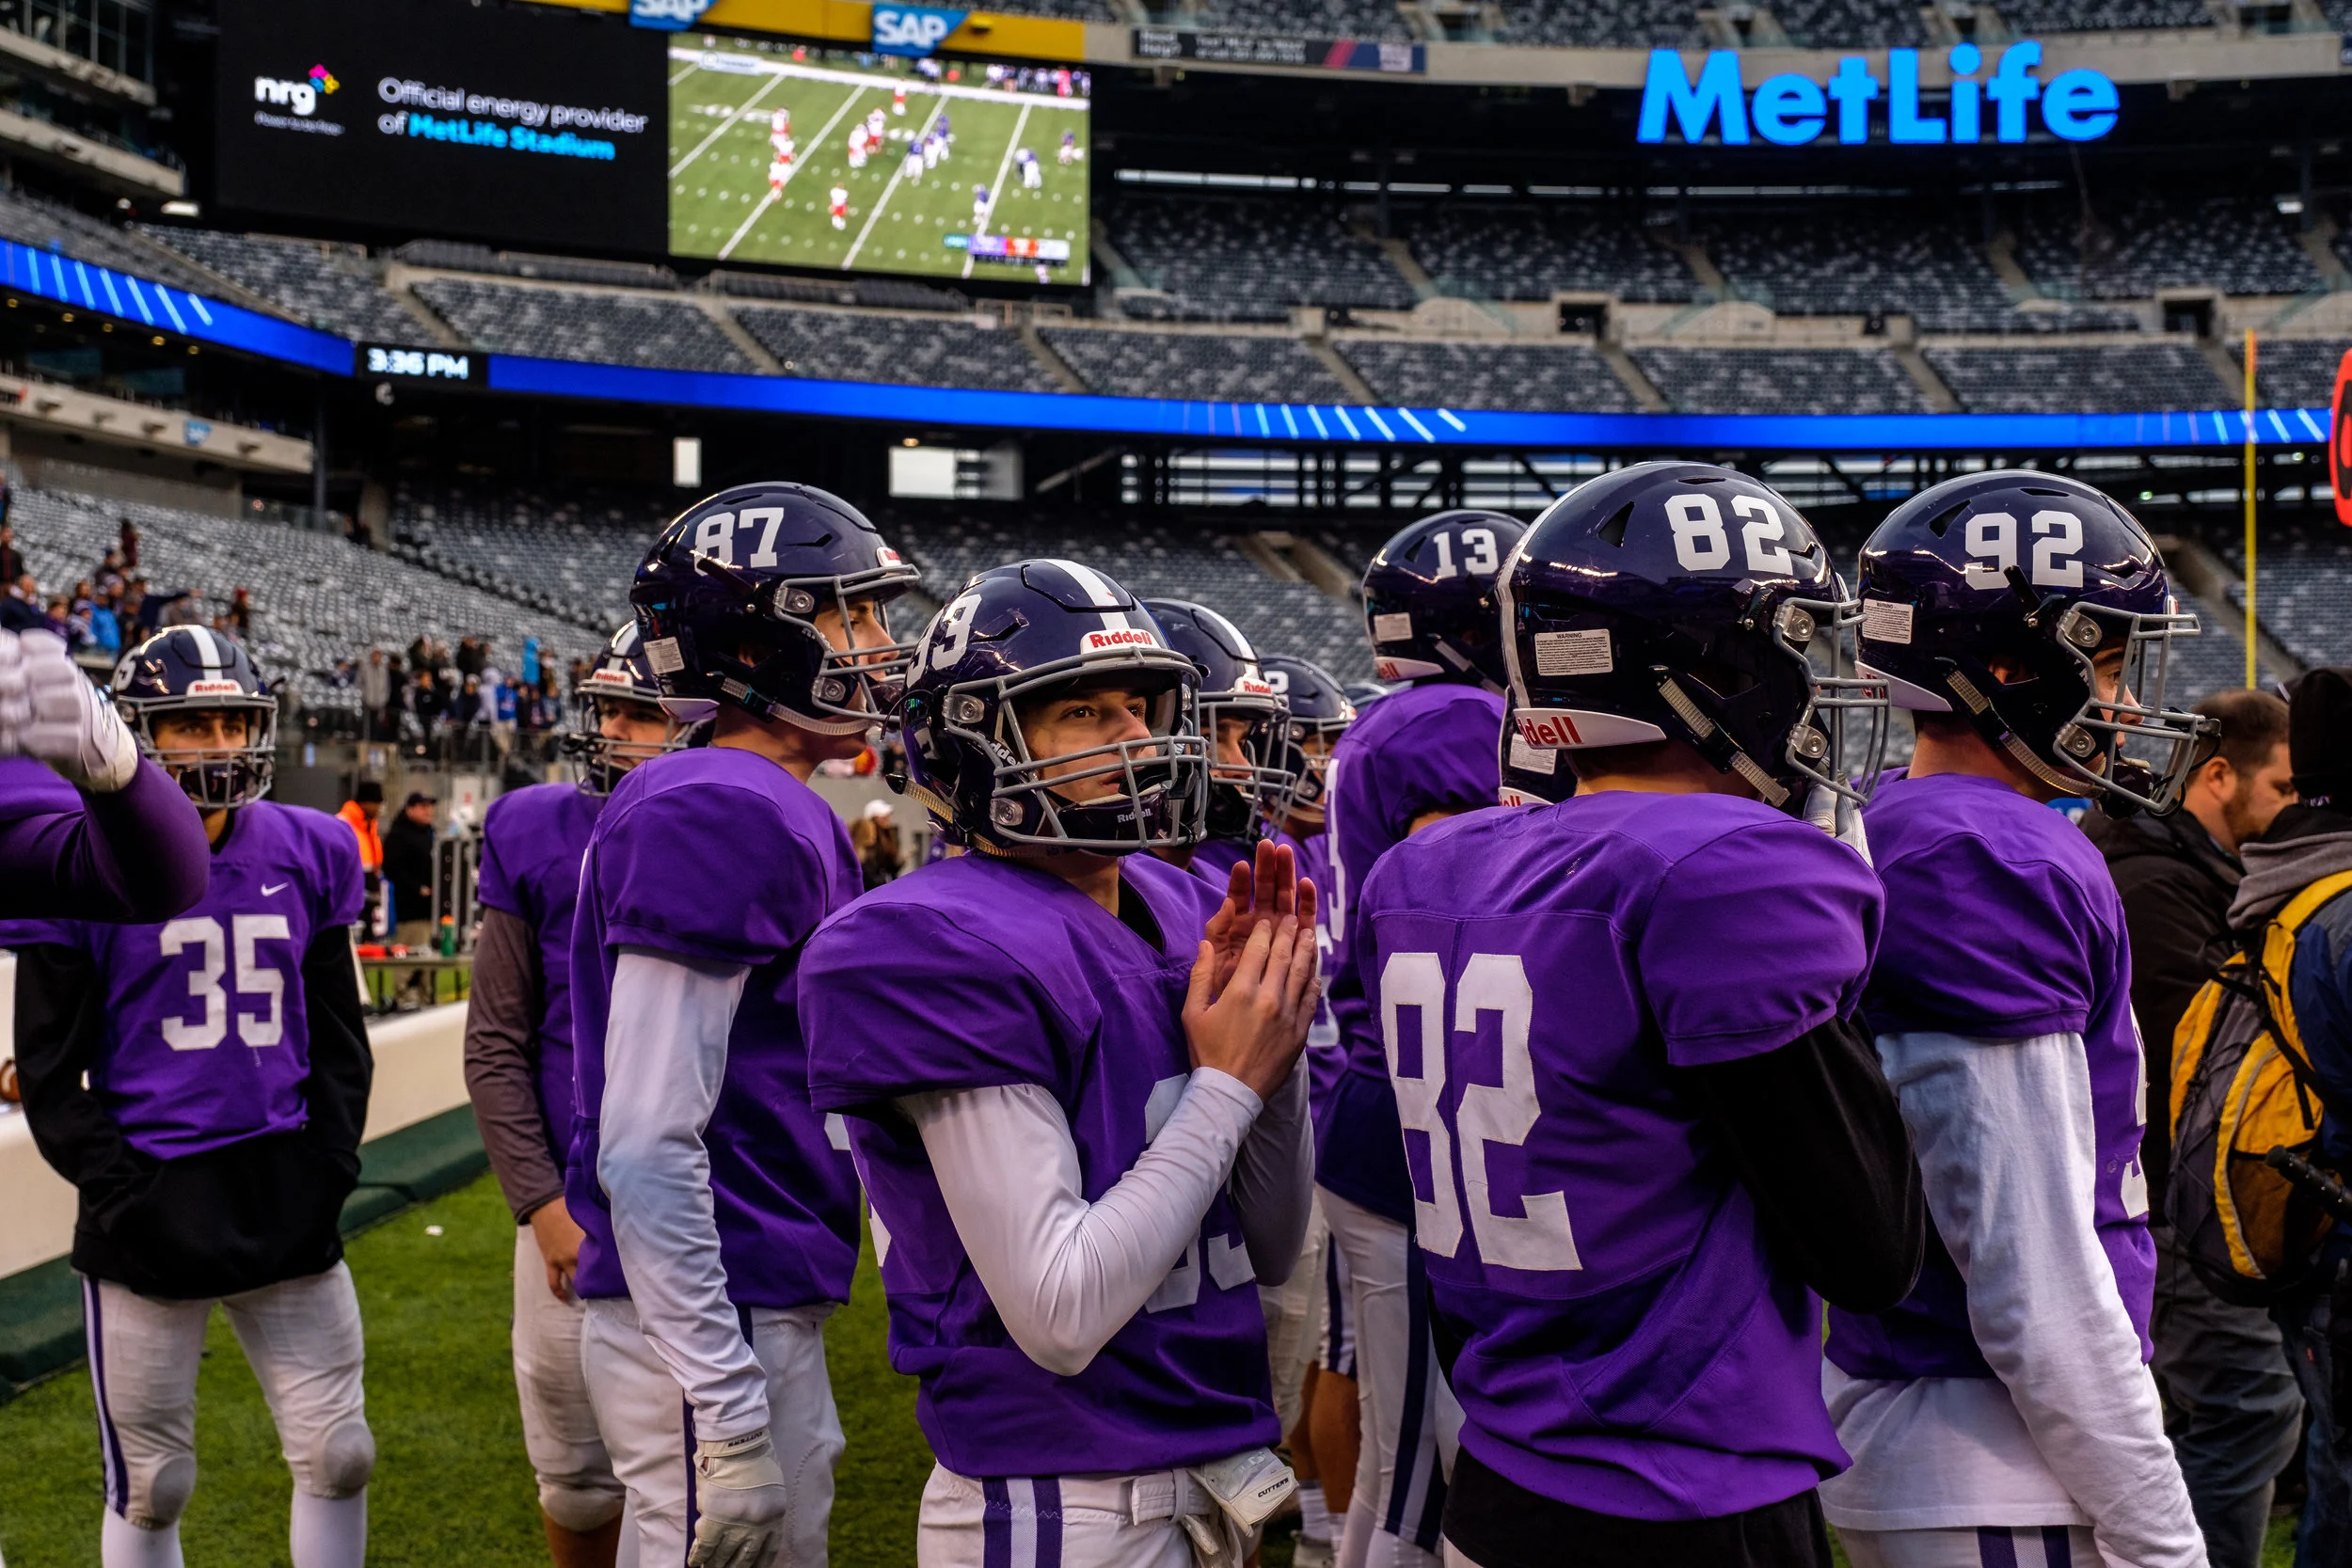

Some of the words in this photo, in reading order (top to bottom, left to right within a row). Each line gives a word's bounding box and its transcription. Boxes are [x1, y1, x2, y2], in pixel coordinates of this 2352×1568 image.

[873, 12, 947, 47] SAP
[254, 76, 316, 116] nrg
[377, 77, 466, 112] Official
[466, 93, 550, 127] energy
[550, 103, 649, 134] provider
[1637, 40, 2120, 146] MetLife
[377, 110, 409, 135] of
[408, 112, 508, 149] MetLife
[509, 125, 616, 161] Stadium
[426, 353, 469, 380] PM
[694, 507, 785, 577] 87
[1433, 528, 1500, 580] 13
[1663, 493, 1793, 576] 82
[1965, 510, 2083, 591] 92
[1089, 630, 1152, 648] Riddell
[114, 645, 143, 692] 5
[159, 913, 291, 1052] 35
[1380, 952, 1583, 1271] 82
[1257, 1477, 1289, 1497] CUTTERS
